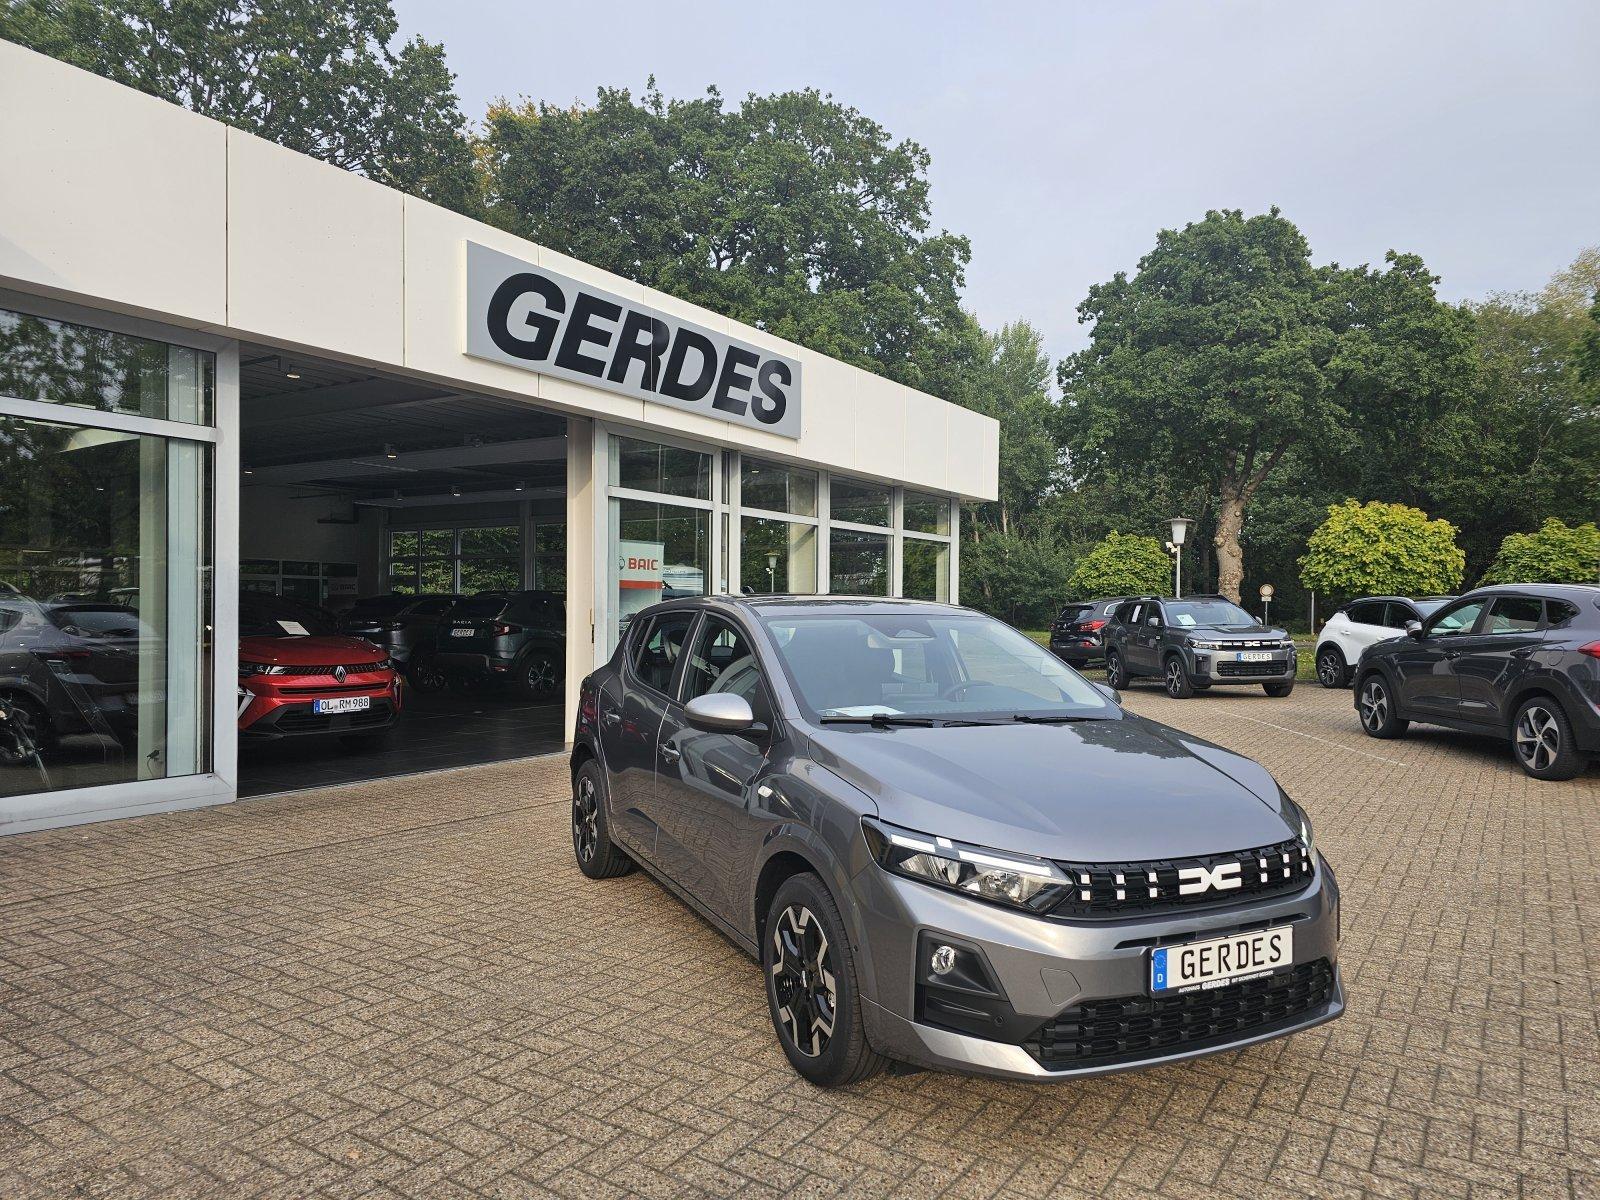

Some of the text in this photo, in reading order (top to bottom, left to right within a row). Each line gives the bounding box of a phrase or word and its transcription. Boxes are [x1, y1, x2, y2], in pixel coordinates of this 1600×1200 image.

[487, 272, 792, 425] GERDES
[628, 557, 659, 571] BAIC
[320, 697, 369, 711] OL RM 988
[1180, 934, 1282, 980] GERDES
[1201, 977, 1231, 991] GERDES
